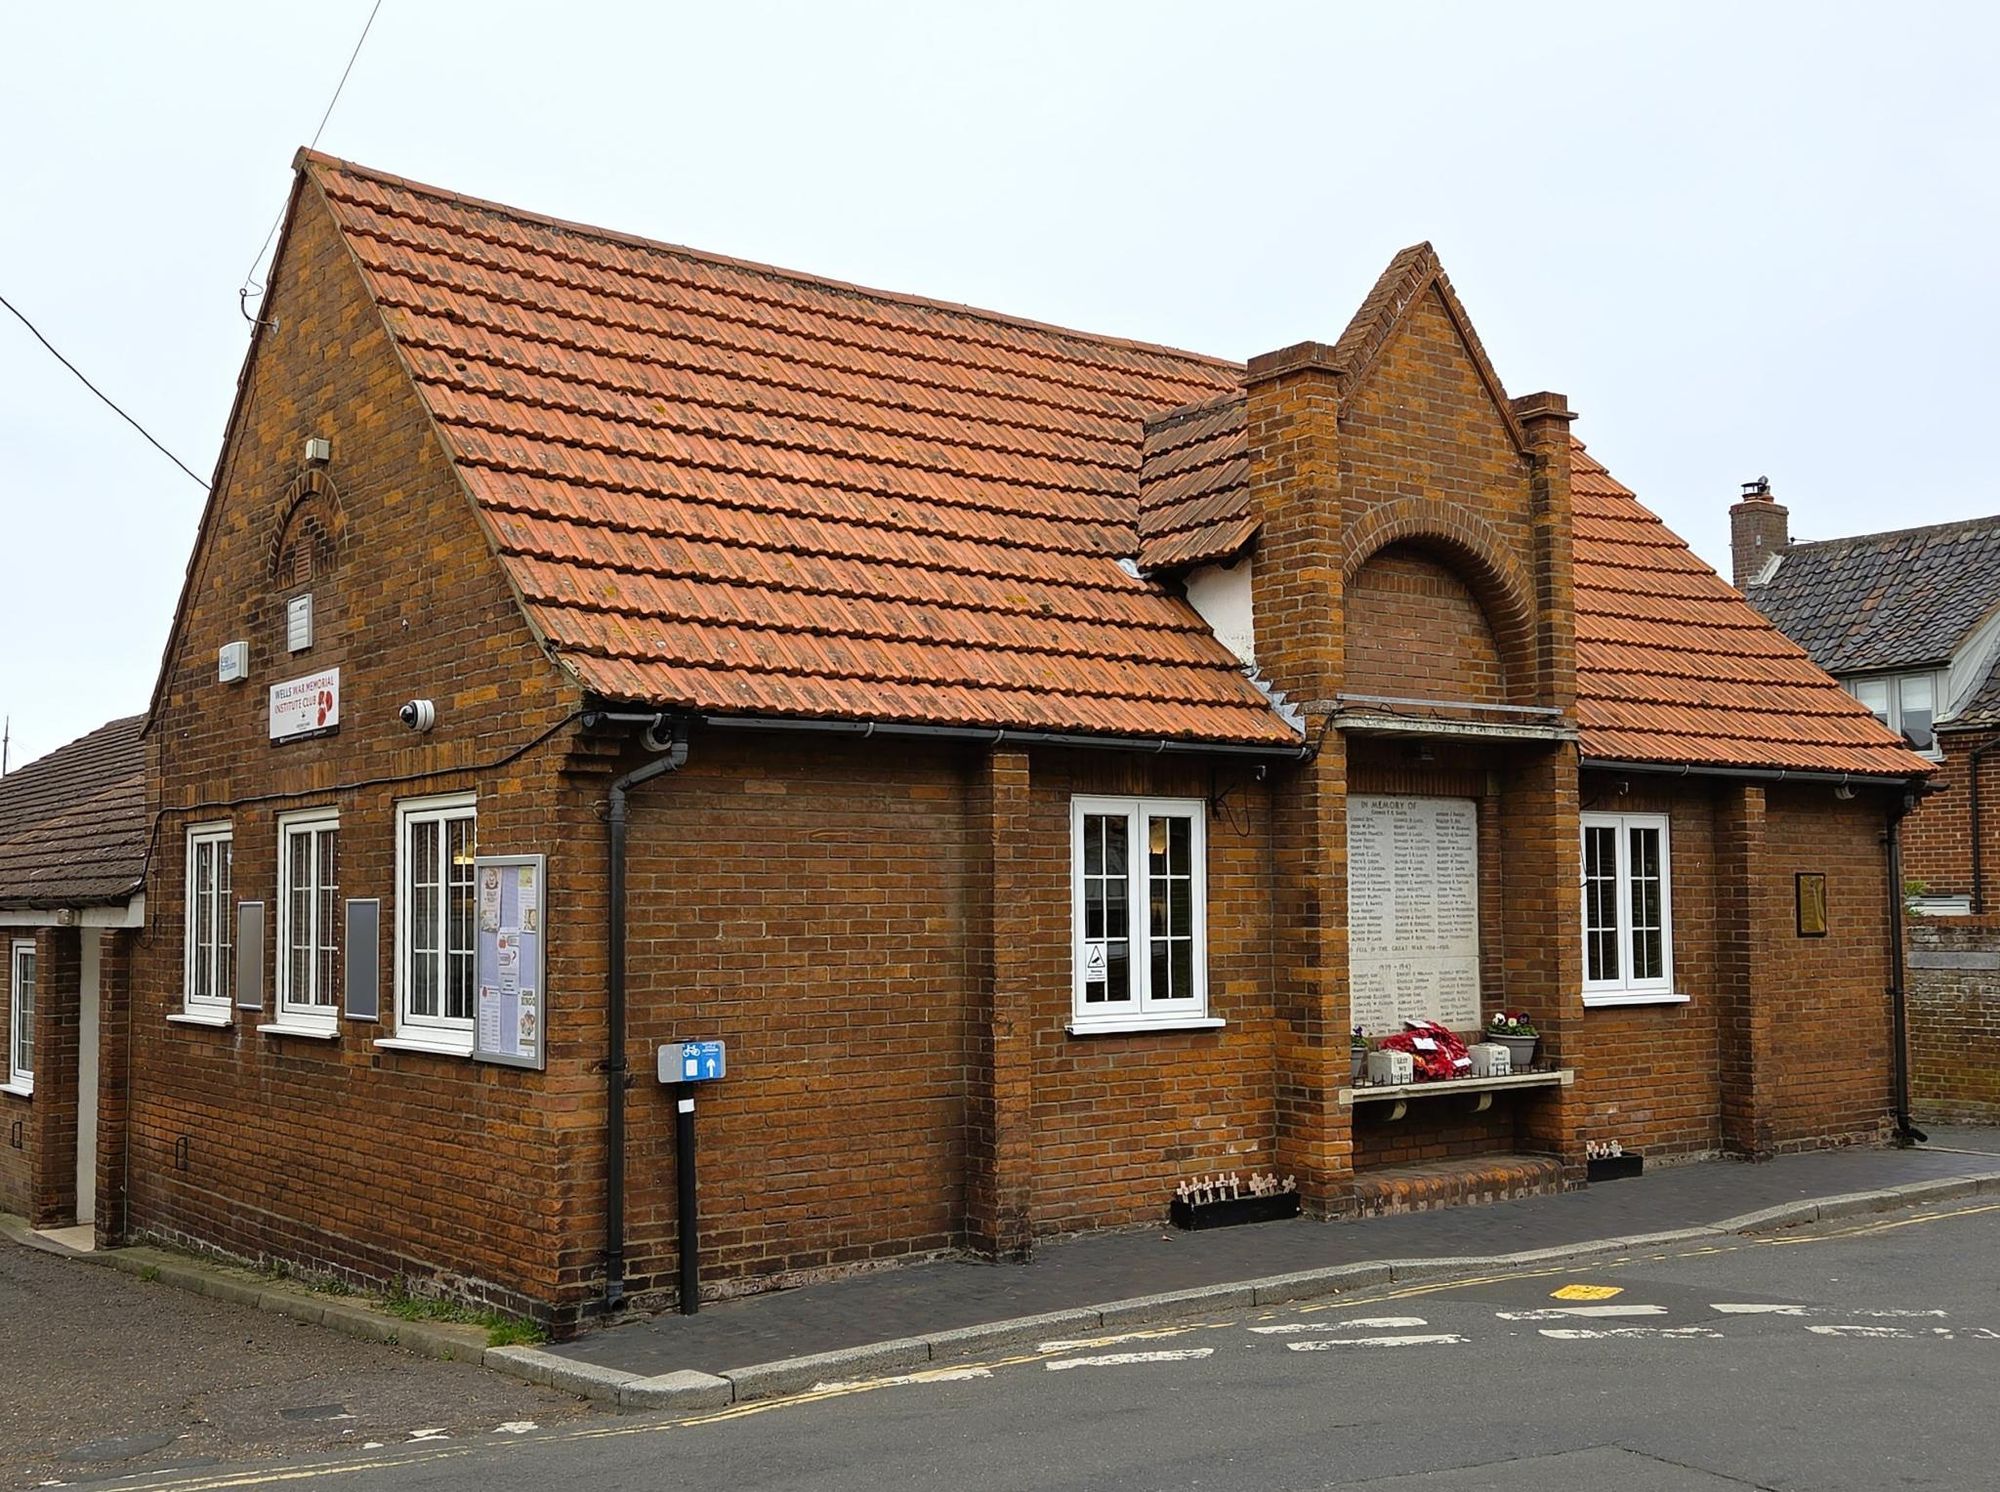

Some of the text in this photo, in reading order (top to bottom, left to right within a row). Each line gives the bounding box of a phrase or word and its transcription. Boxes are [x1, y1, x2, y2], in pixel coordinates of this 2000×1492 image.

[275, 676, 334, 699] WELLS WAR MEMORIAL
[275, 695, 316, 714] INSTITUTE CLUB
[1361, 801, 1417, 810] IN MEMORY OF
[1392, 943, 1409, 952] GREAT
